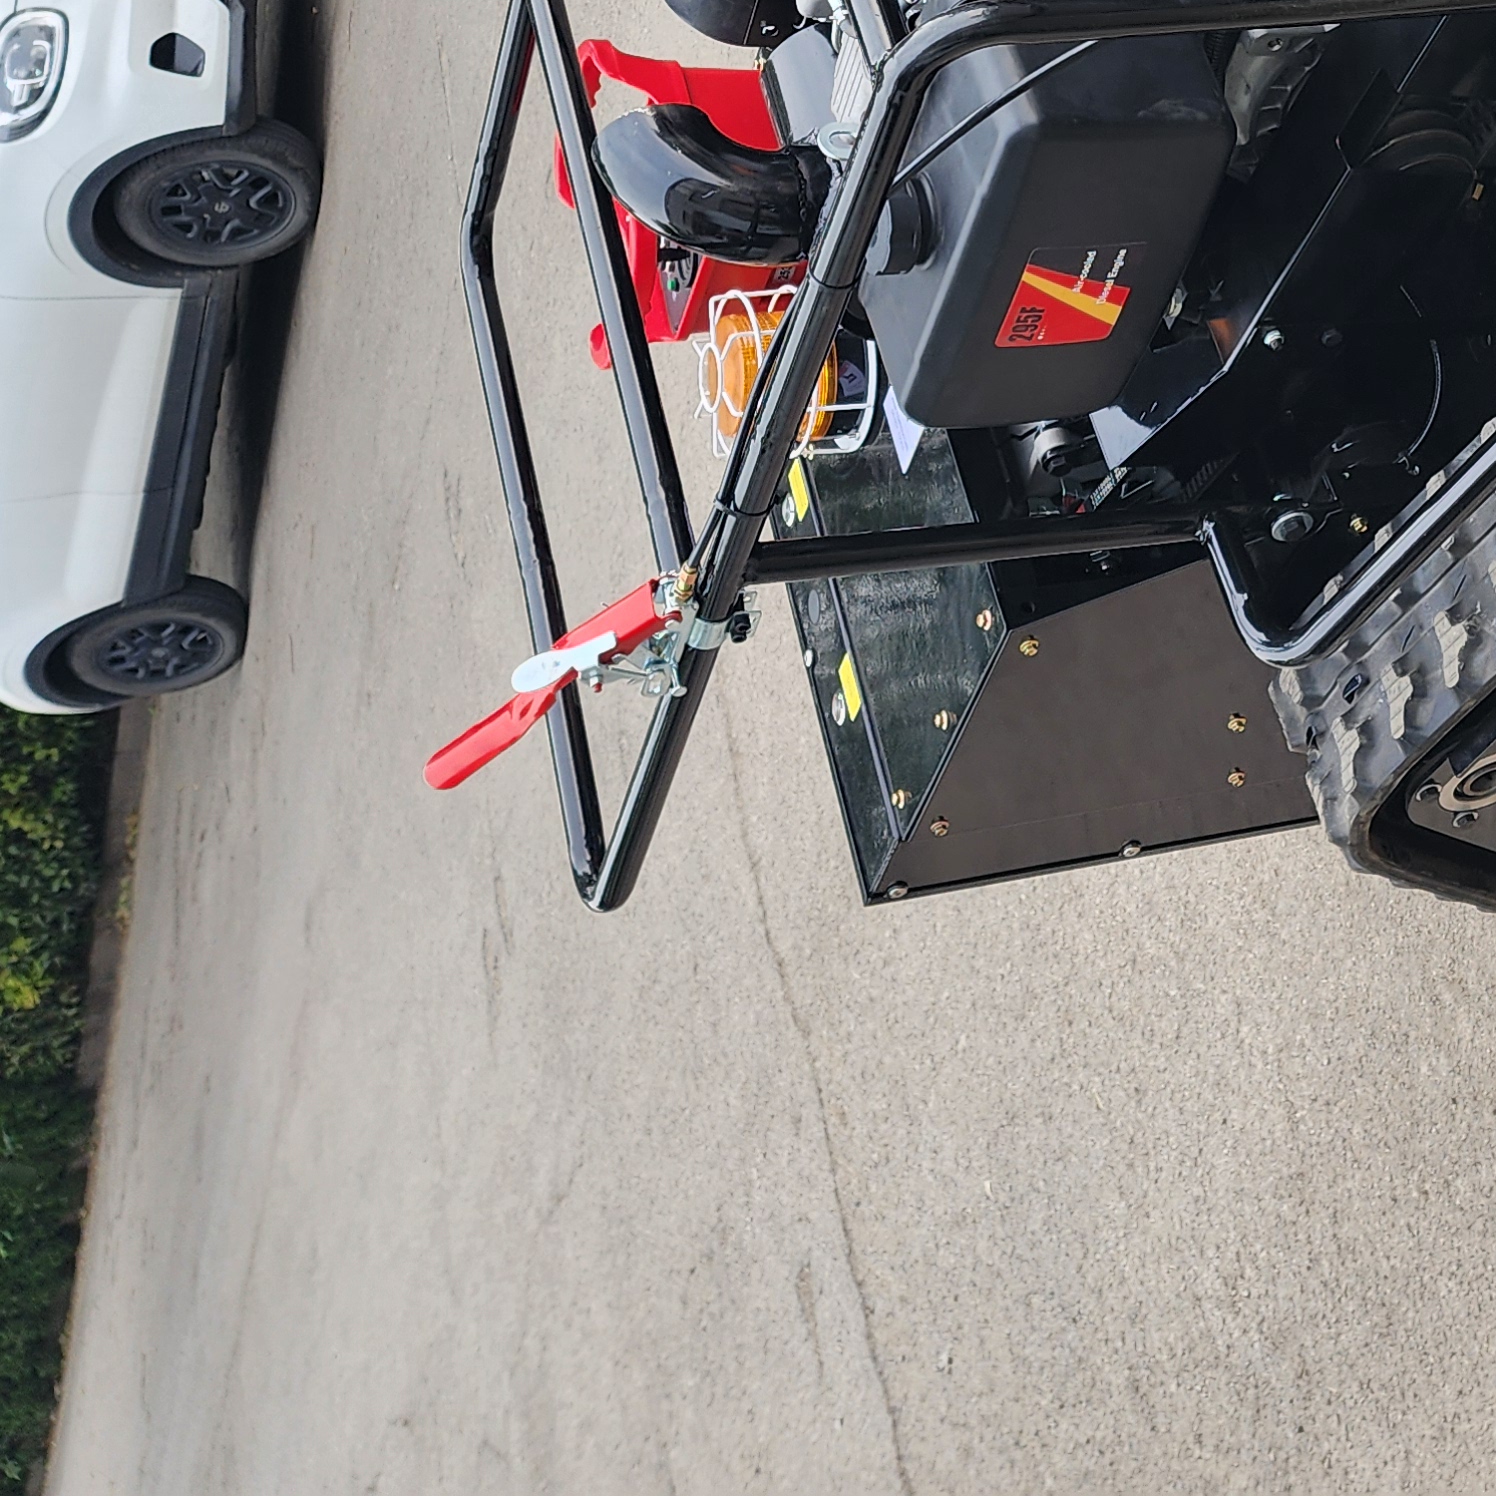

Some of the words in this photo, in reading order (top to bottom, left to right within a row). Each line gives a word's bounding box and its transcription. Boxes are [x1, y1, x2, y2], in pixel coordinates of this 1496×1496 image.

[1071, 250, 1097, 294] Air-cooled
[1095, 279, 1115, 305] Diesel
[1105, 248, 1128, 278] Engine
[1007, 305, 1045, 343] 295F
